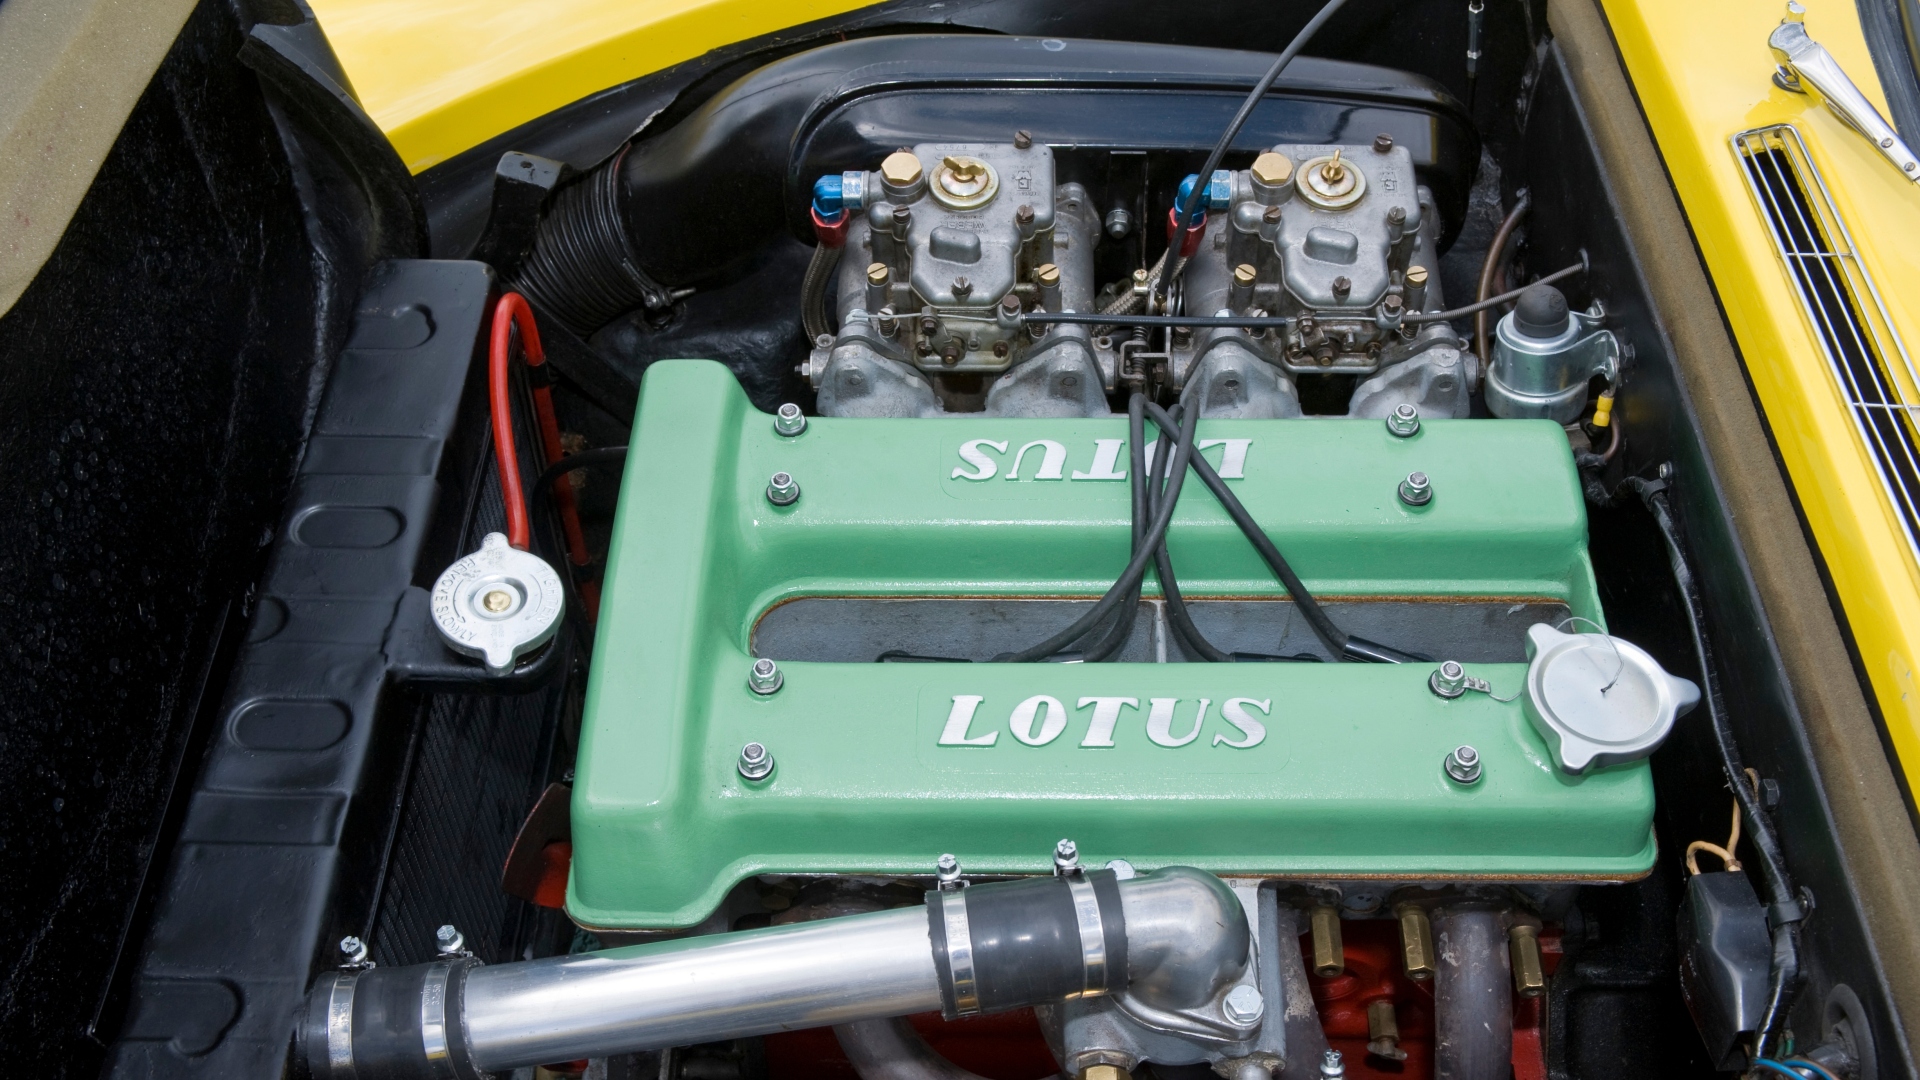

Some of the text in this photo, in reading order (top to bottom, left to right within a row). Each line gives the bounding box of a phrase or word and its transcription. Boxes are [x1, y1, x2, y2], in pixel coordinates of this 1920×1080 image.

[434, 557, 478, 642] REMOVE SLOWLY
[535, 564, 559, 625] TIGHTEN
[937, 695, 1272, 748] LOTUS
